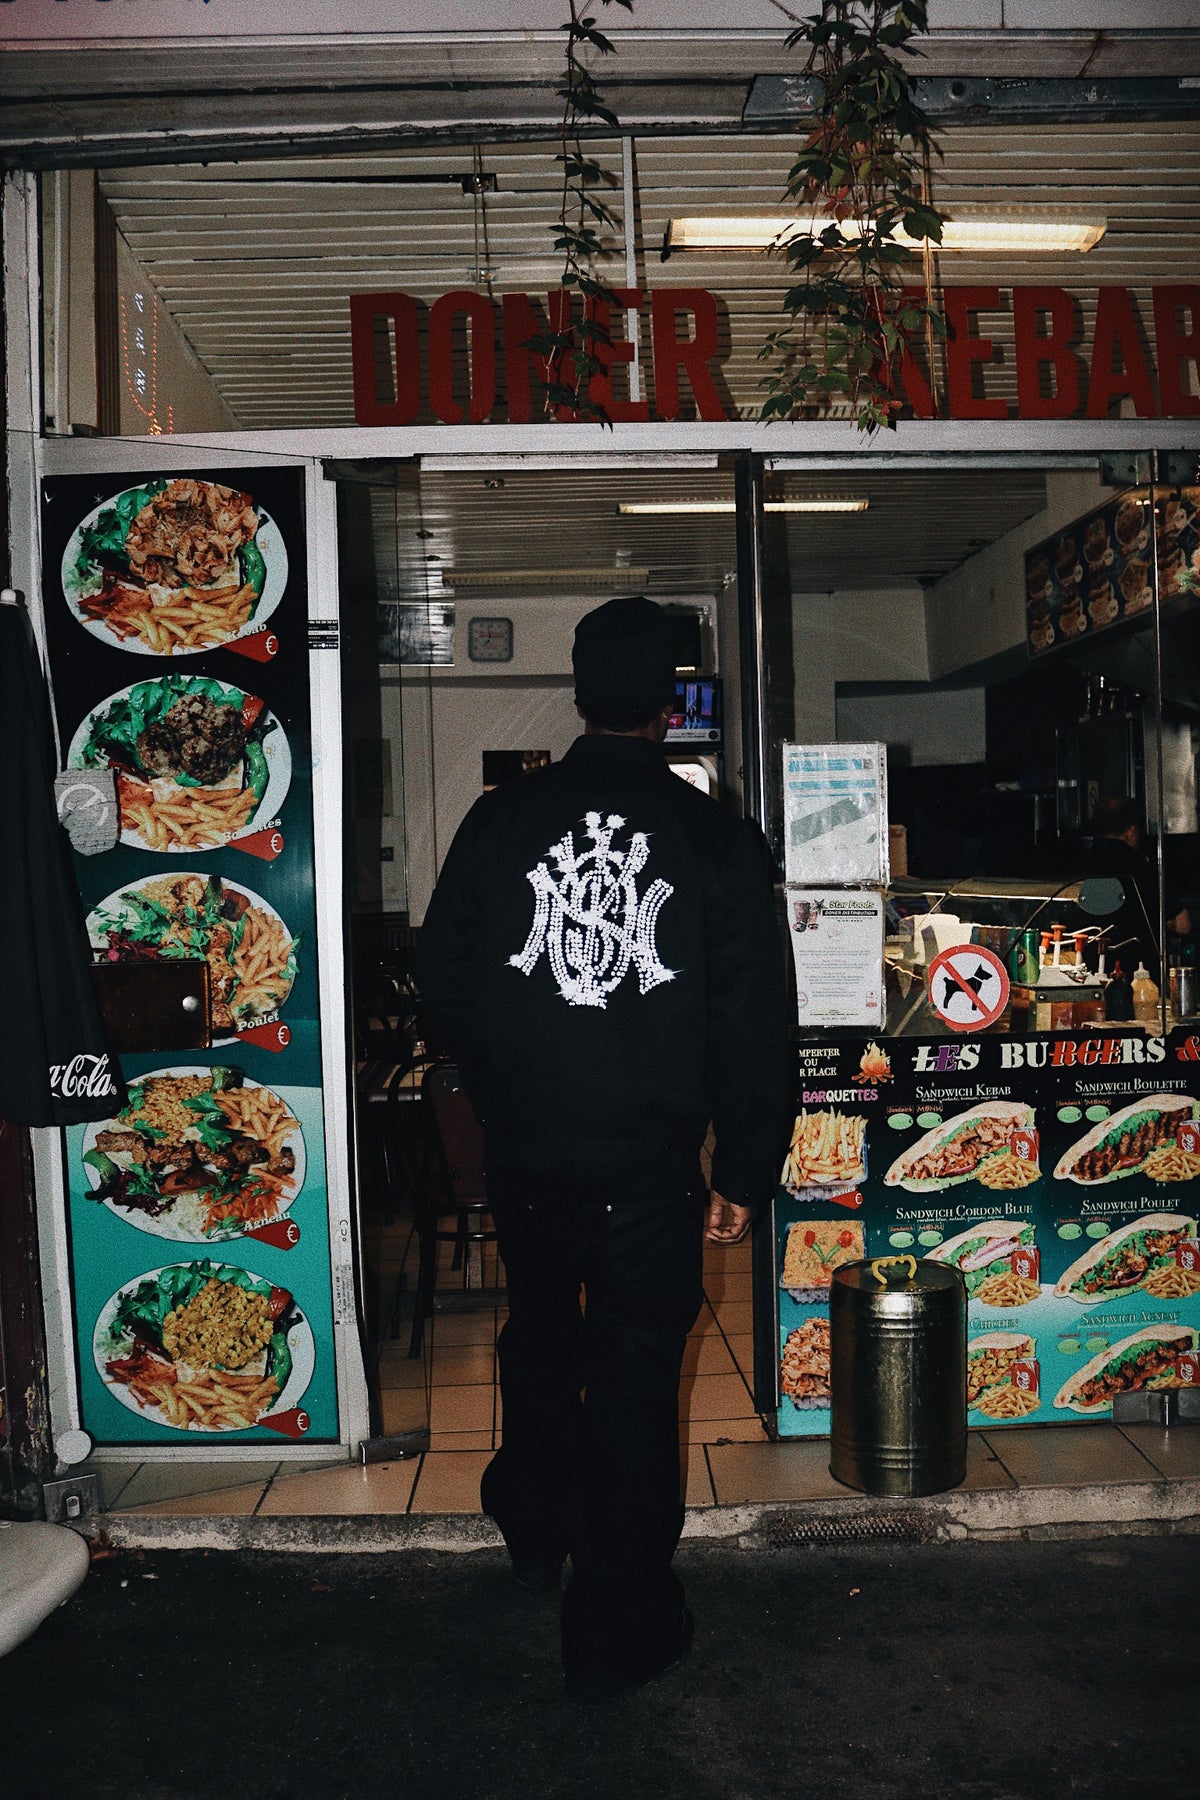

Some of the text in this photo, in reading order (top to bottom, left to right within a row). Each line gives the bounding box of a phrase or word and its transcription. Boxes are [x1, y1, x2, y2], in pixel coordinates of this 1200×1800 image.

[350, 288, 727, 427] DONER
[227, 623, 267, 641] Kbab
[223, 818, 282, 841] Botes
[237, 1012, 279, 1032] Poulet
[803, 1058, 819, 1067] OU
[911, 1043, 982, 1072] LES
[1000, 1037, 1166, 1069] BURGERS
[807, 1066, 838, 1077] PLACE
[915, 1083, 1012, 1099] SANDWICH KEBAB
[1075, 1078, 1187, 1093] SANDWICH BOULETTE
[802, 1088, 879, 1103] BARQUETTES
[895, 1202, 1033, 1220] SANDWICH CORDON BLUE
[1082, 1197, 1181, 1212] SANDWICH POULET
[244, 1212, 291, 1231] Agneau
